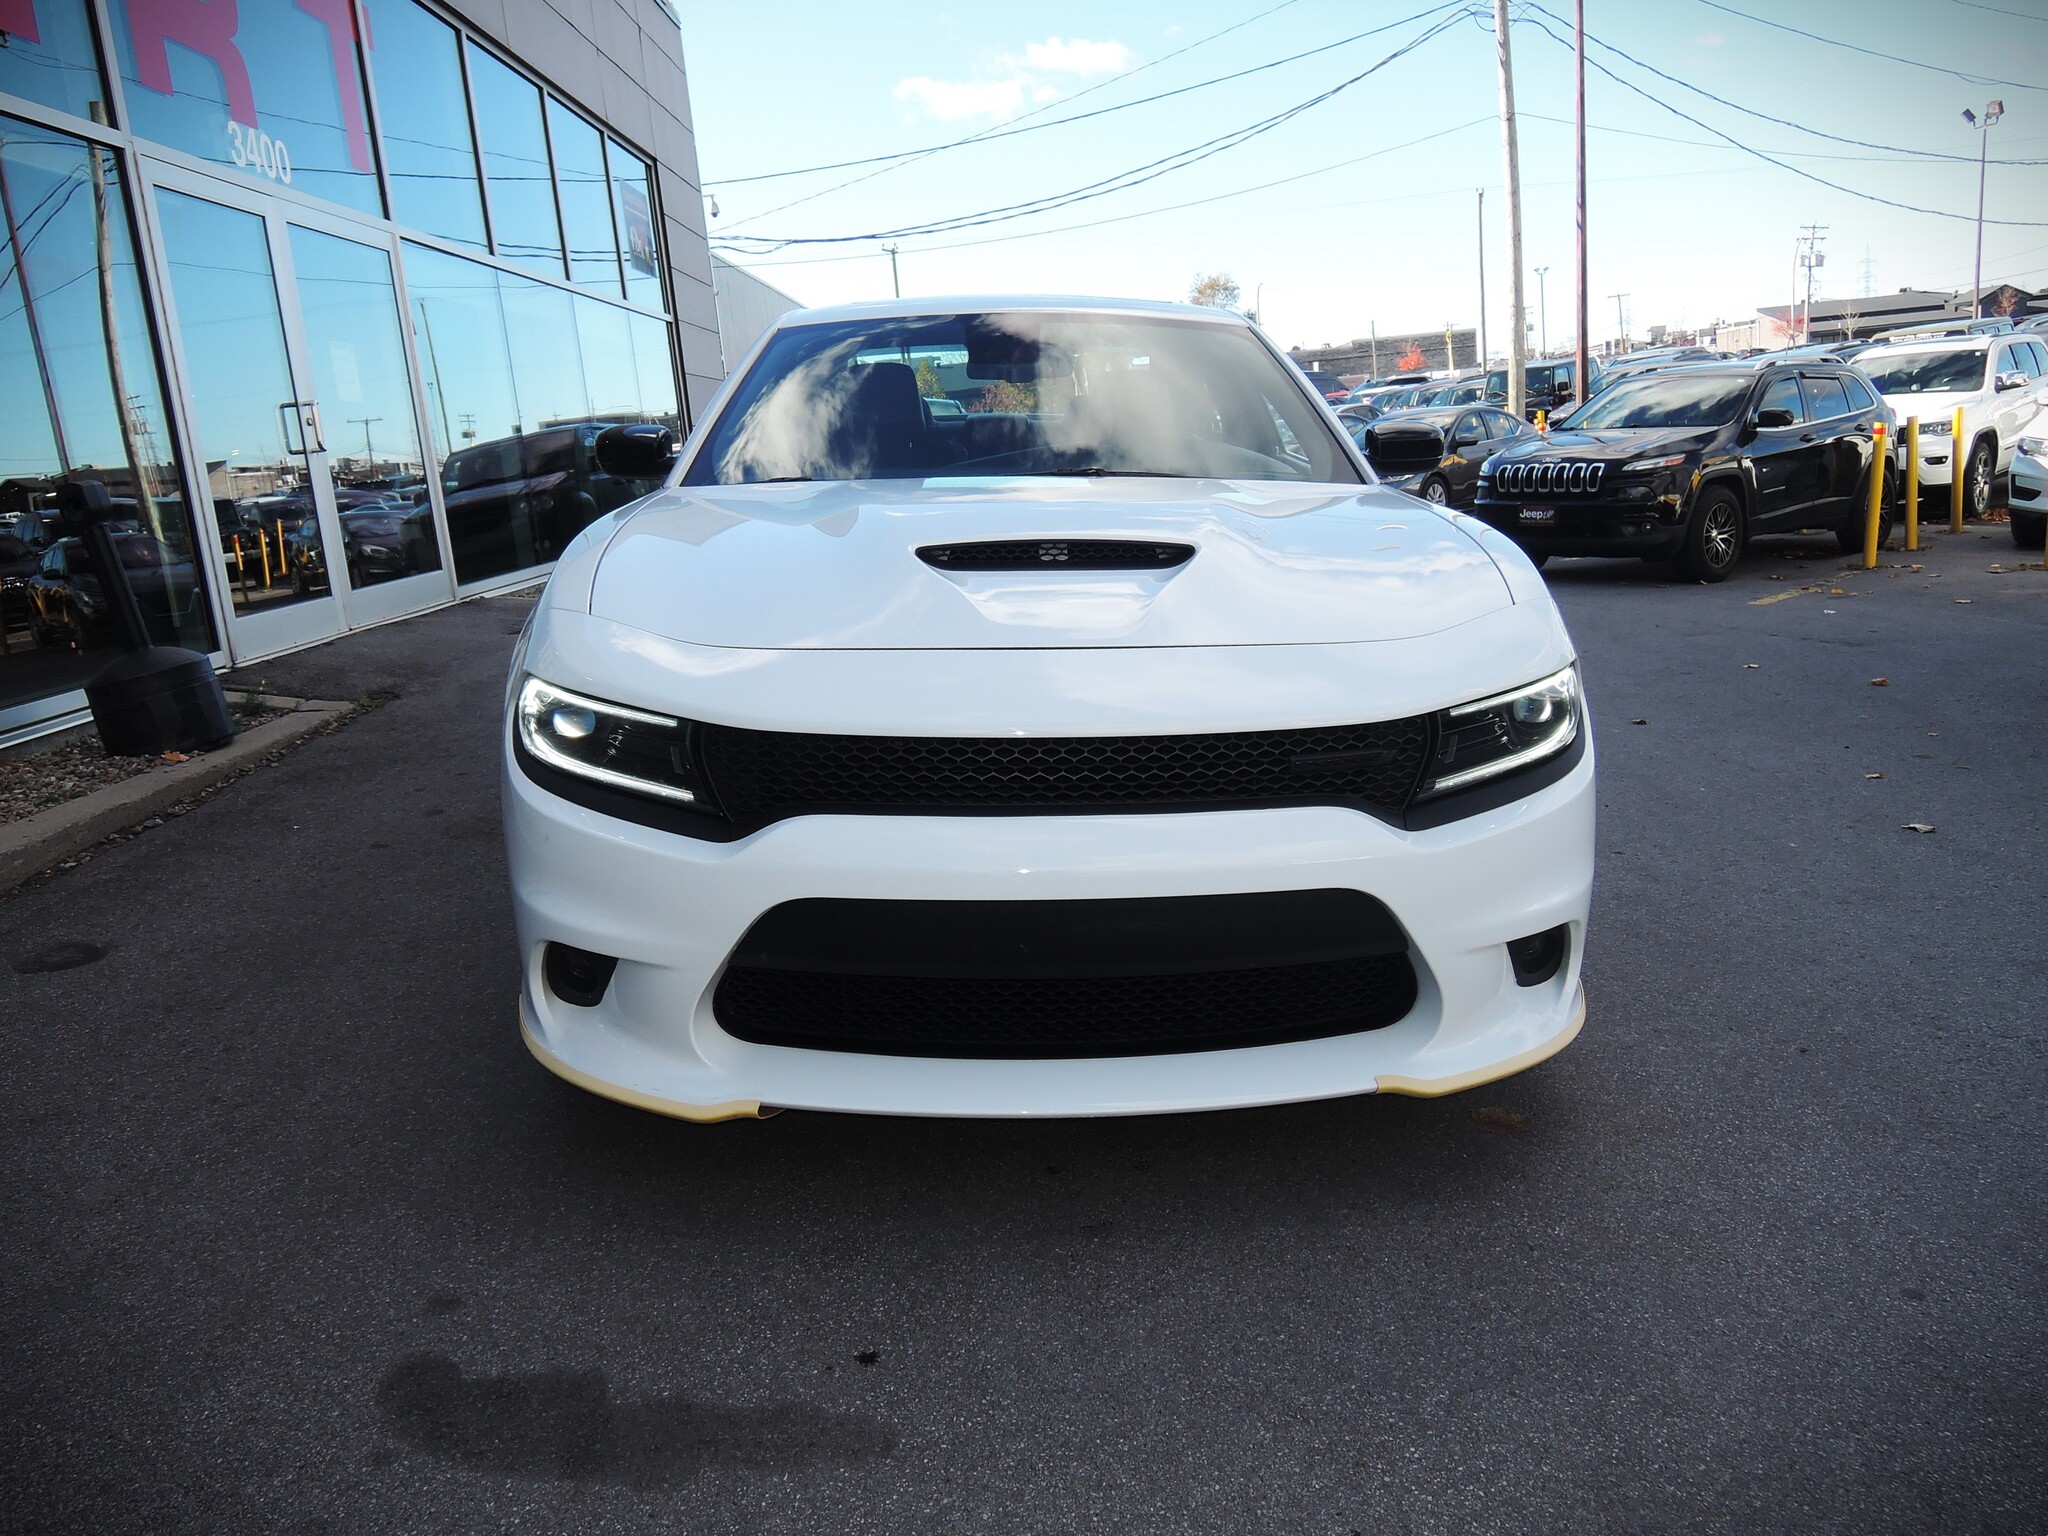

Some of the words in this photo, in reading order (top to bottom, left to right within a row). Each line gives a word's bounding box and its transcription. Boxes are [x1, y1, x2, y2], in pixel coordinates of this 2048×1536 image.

[0, 0, 374, 174] RT
[227, 121, 292, 185] 3400
[1519, 508, 1543, 520] Jeep
